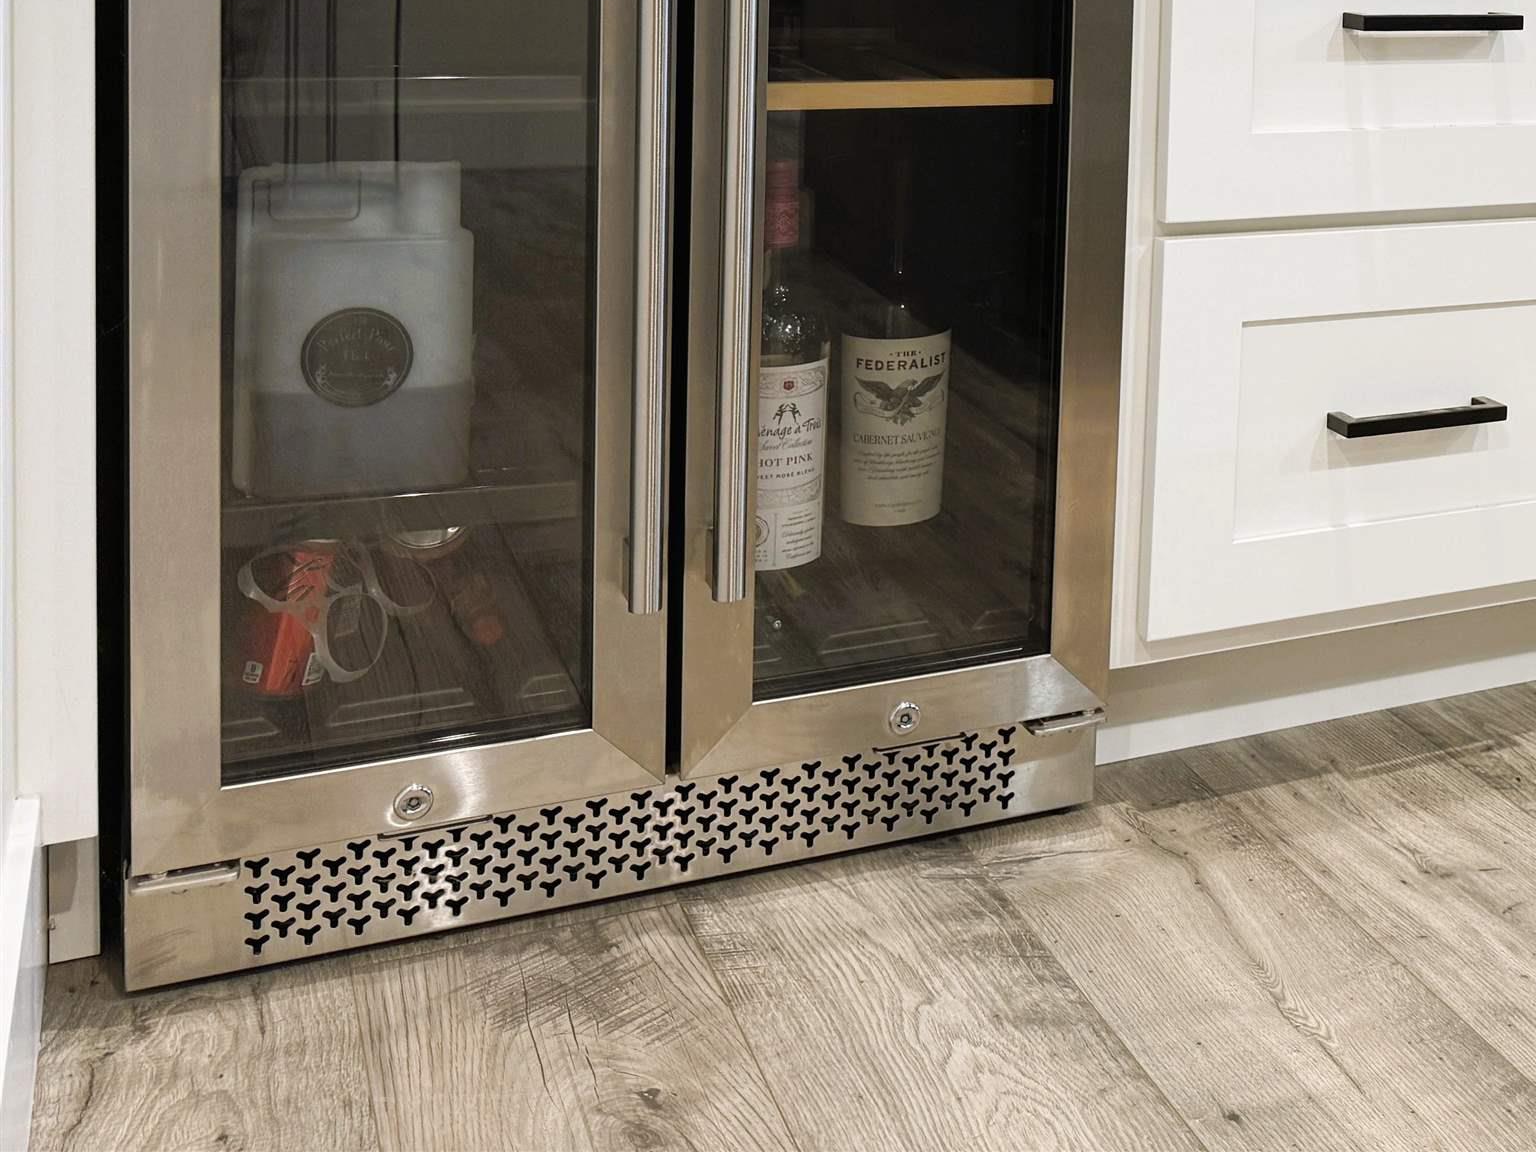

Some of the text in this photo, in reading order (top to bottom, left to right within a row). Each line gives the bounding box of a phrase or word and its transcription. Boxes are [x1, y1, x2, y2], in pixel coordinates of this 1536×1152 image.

[856, 351, 946, 371] FEDERALIST
[853, 427, 942, 446] CABERNET SAUVIGN
[786, 452, 813, 466] PINK
